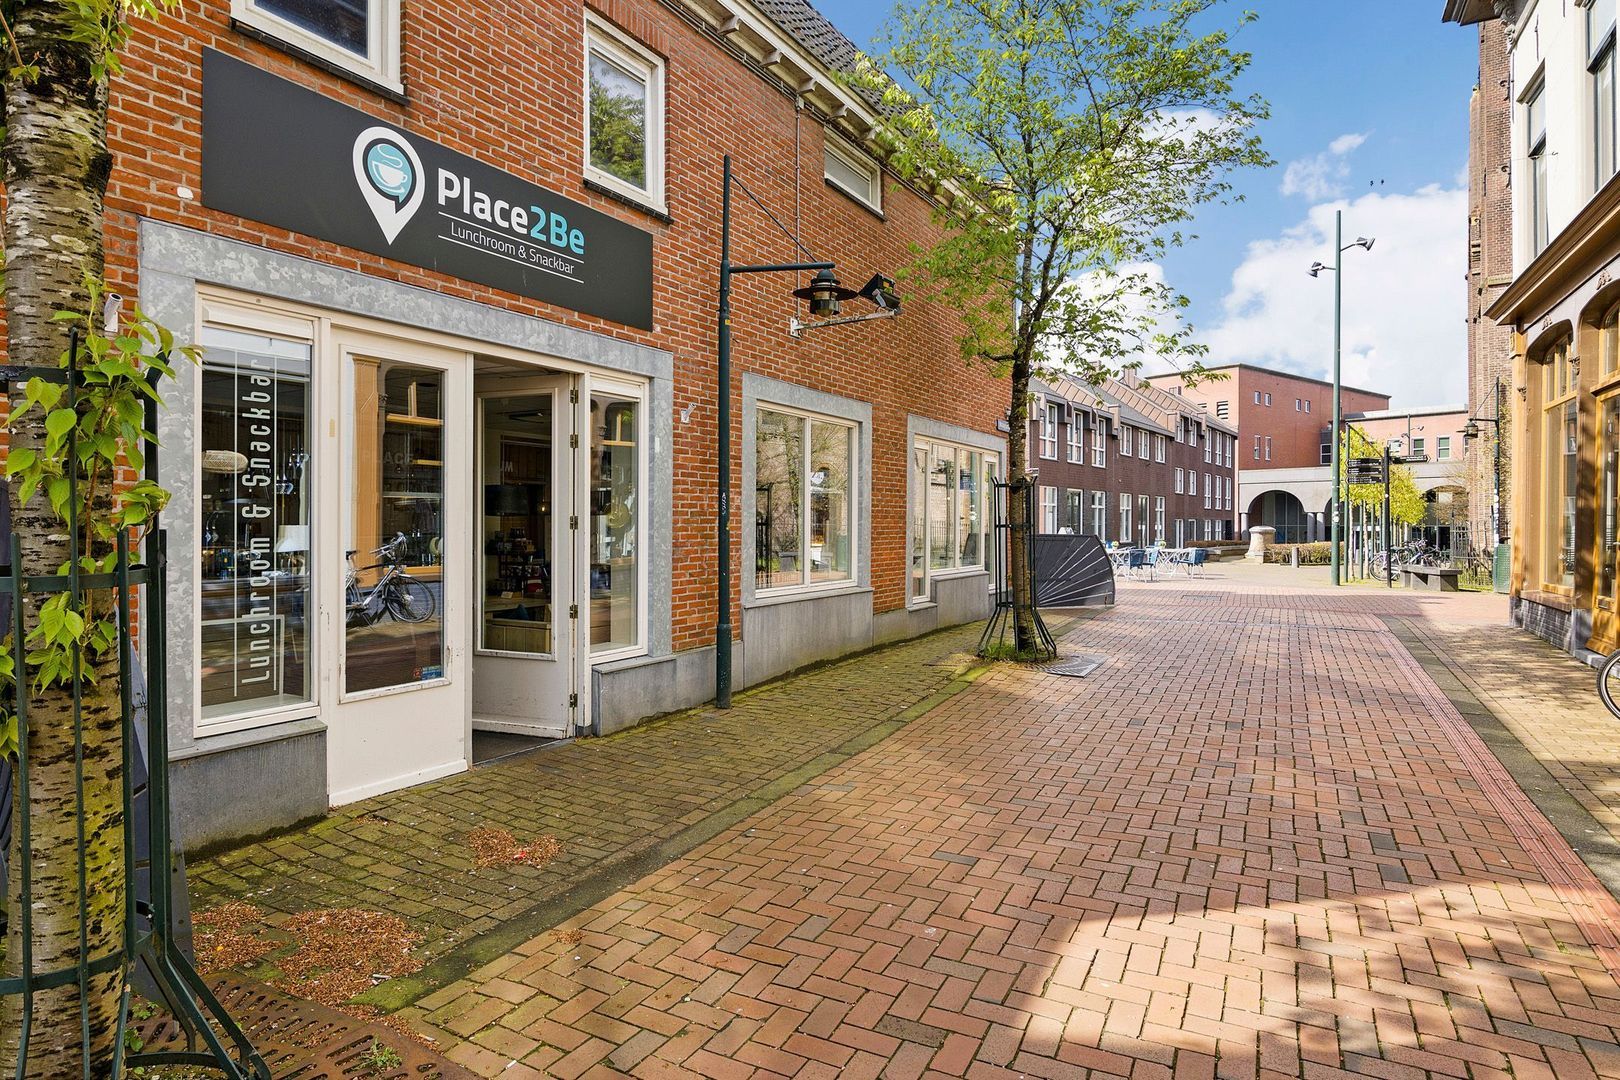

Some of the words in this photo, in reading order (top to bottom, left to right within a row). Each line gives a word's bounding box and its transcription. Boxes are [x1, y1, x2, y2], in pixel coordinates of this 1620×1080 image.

[437, 167, 585, 255] Place2Be
[451, 222, 516, 256] Lunchroom
[518, 245, 527, 259] &
[529, 249, 575, 275] Snackbar
[241, 359, 271, 487] Snackbar
[241, 505, 272, 519] &
[241, 536, 271, 684] Lunchroom
